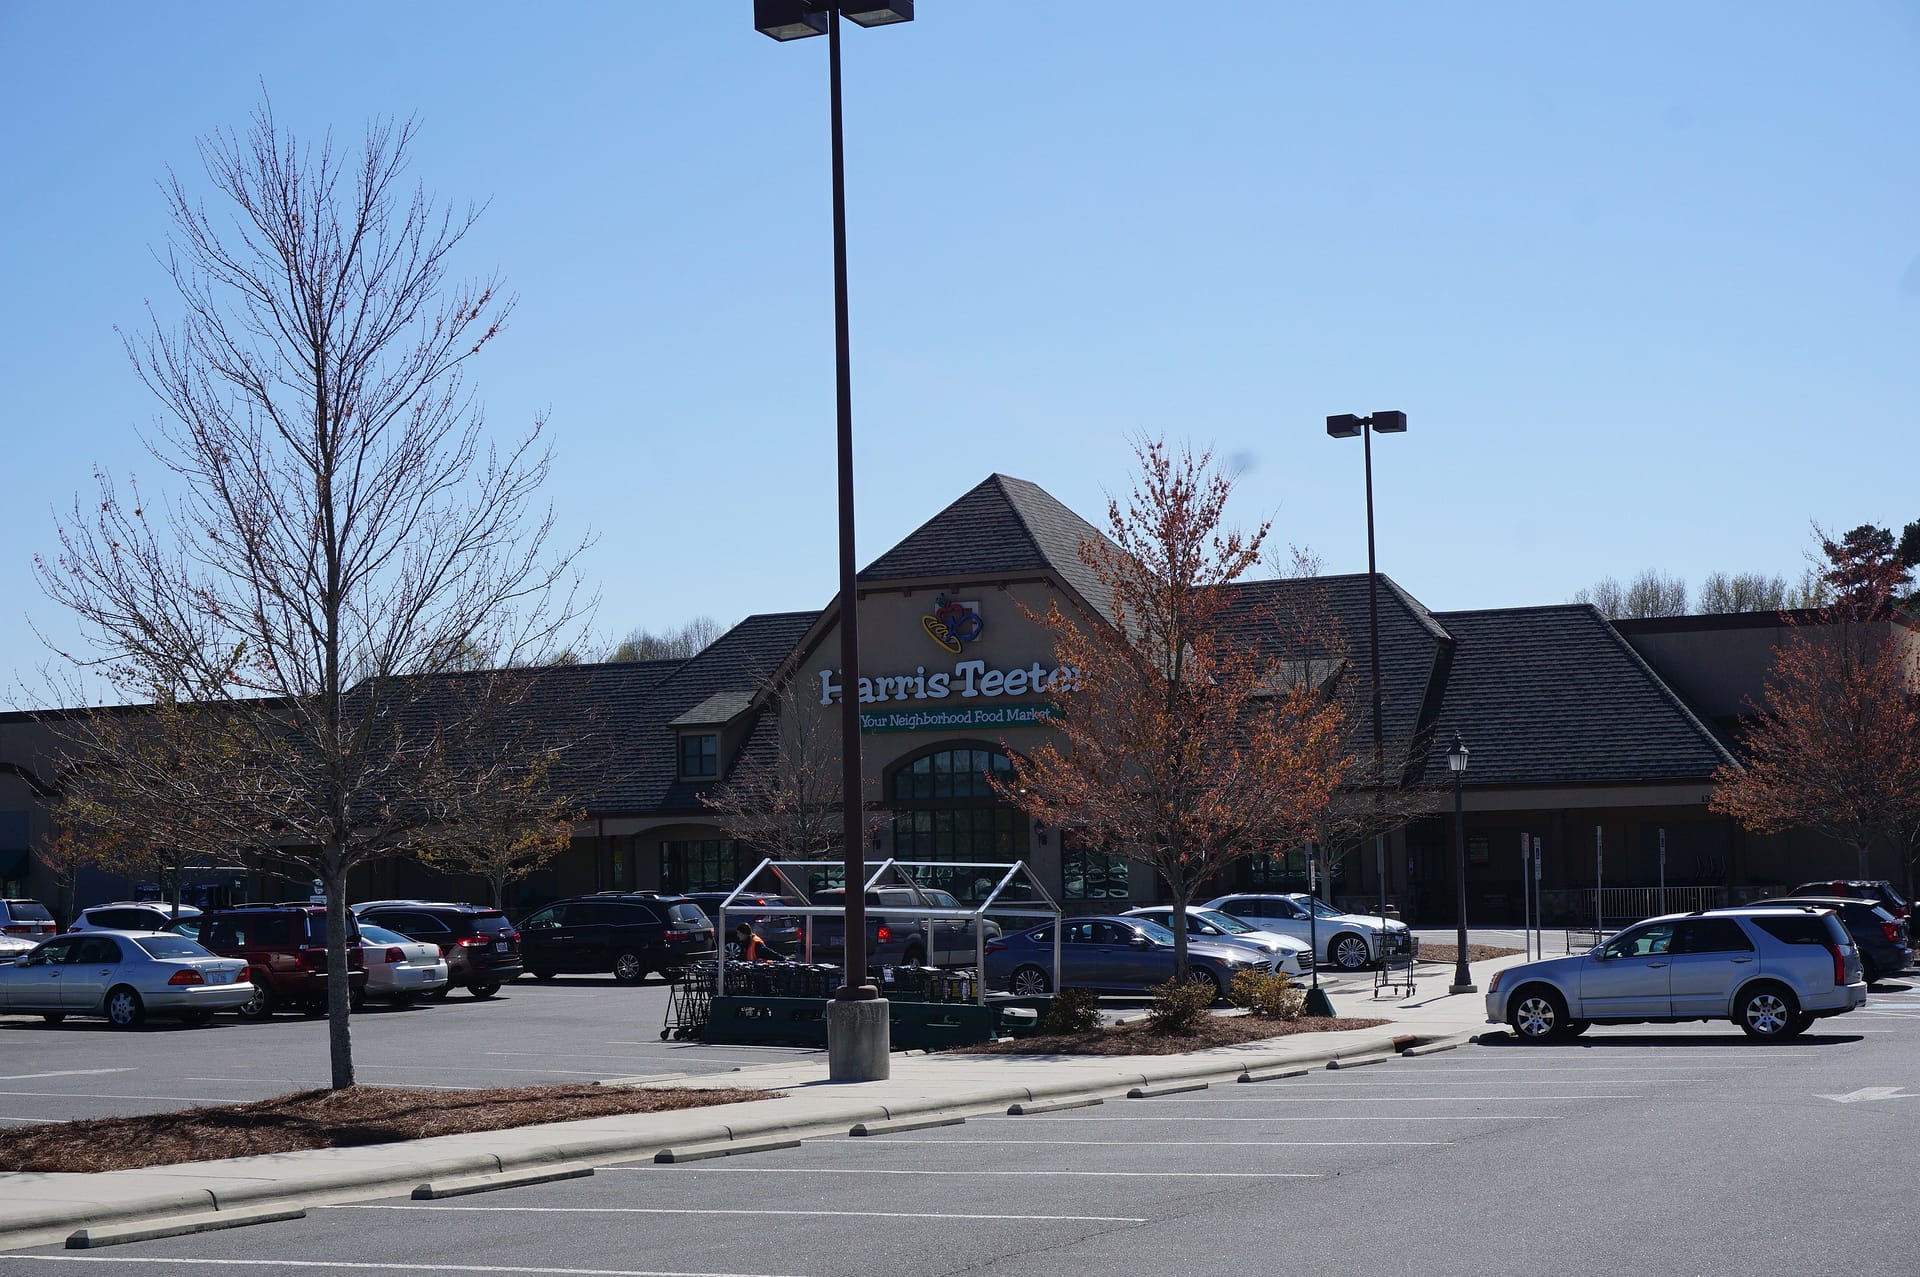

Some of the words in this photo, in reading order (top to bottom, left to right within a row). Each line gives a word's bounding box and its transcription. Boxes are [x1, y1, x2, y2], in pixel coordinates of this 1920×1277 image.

[819, 666, 950, 705] Harris
[861, 715, 888, 728] Your
[890, 711, 972, 729] Neighborhood
[974, 709, 1004, 722] Food
[1006, 708, 1051, 721] Market
